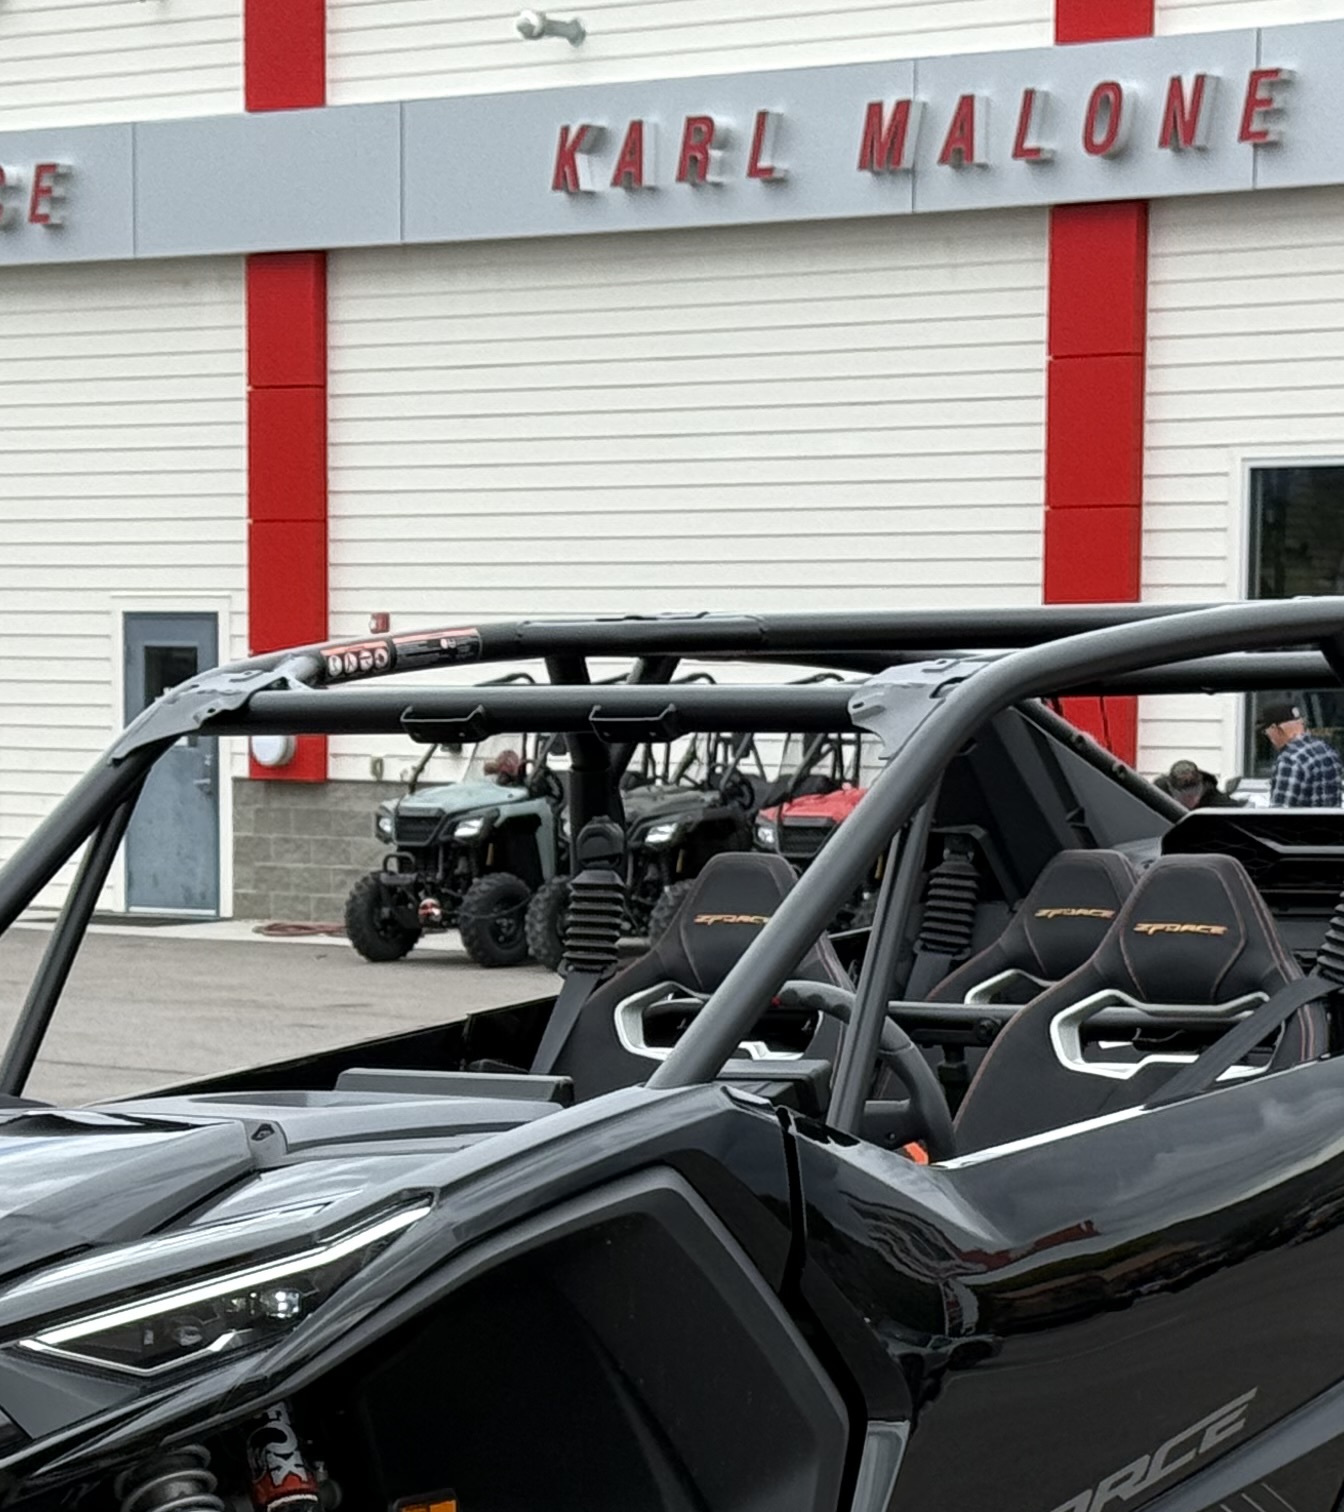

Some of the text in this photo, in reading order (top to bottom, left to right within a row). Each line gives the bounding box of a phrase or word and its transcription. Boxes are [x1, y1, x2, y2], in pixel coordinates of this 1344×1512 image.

[552, 68, 1290, 193] KARL MALONE
[693, 914, 770, 926] ZFORC
[1133, 922, 1229, 936] ZFORCE
